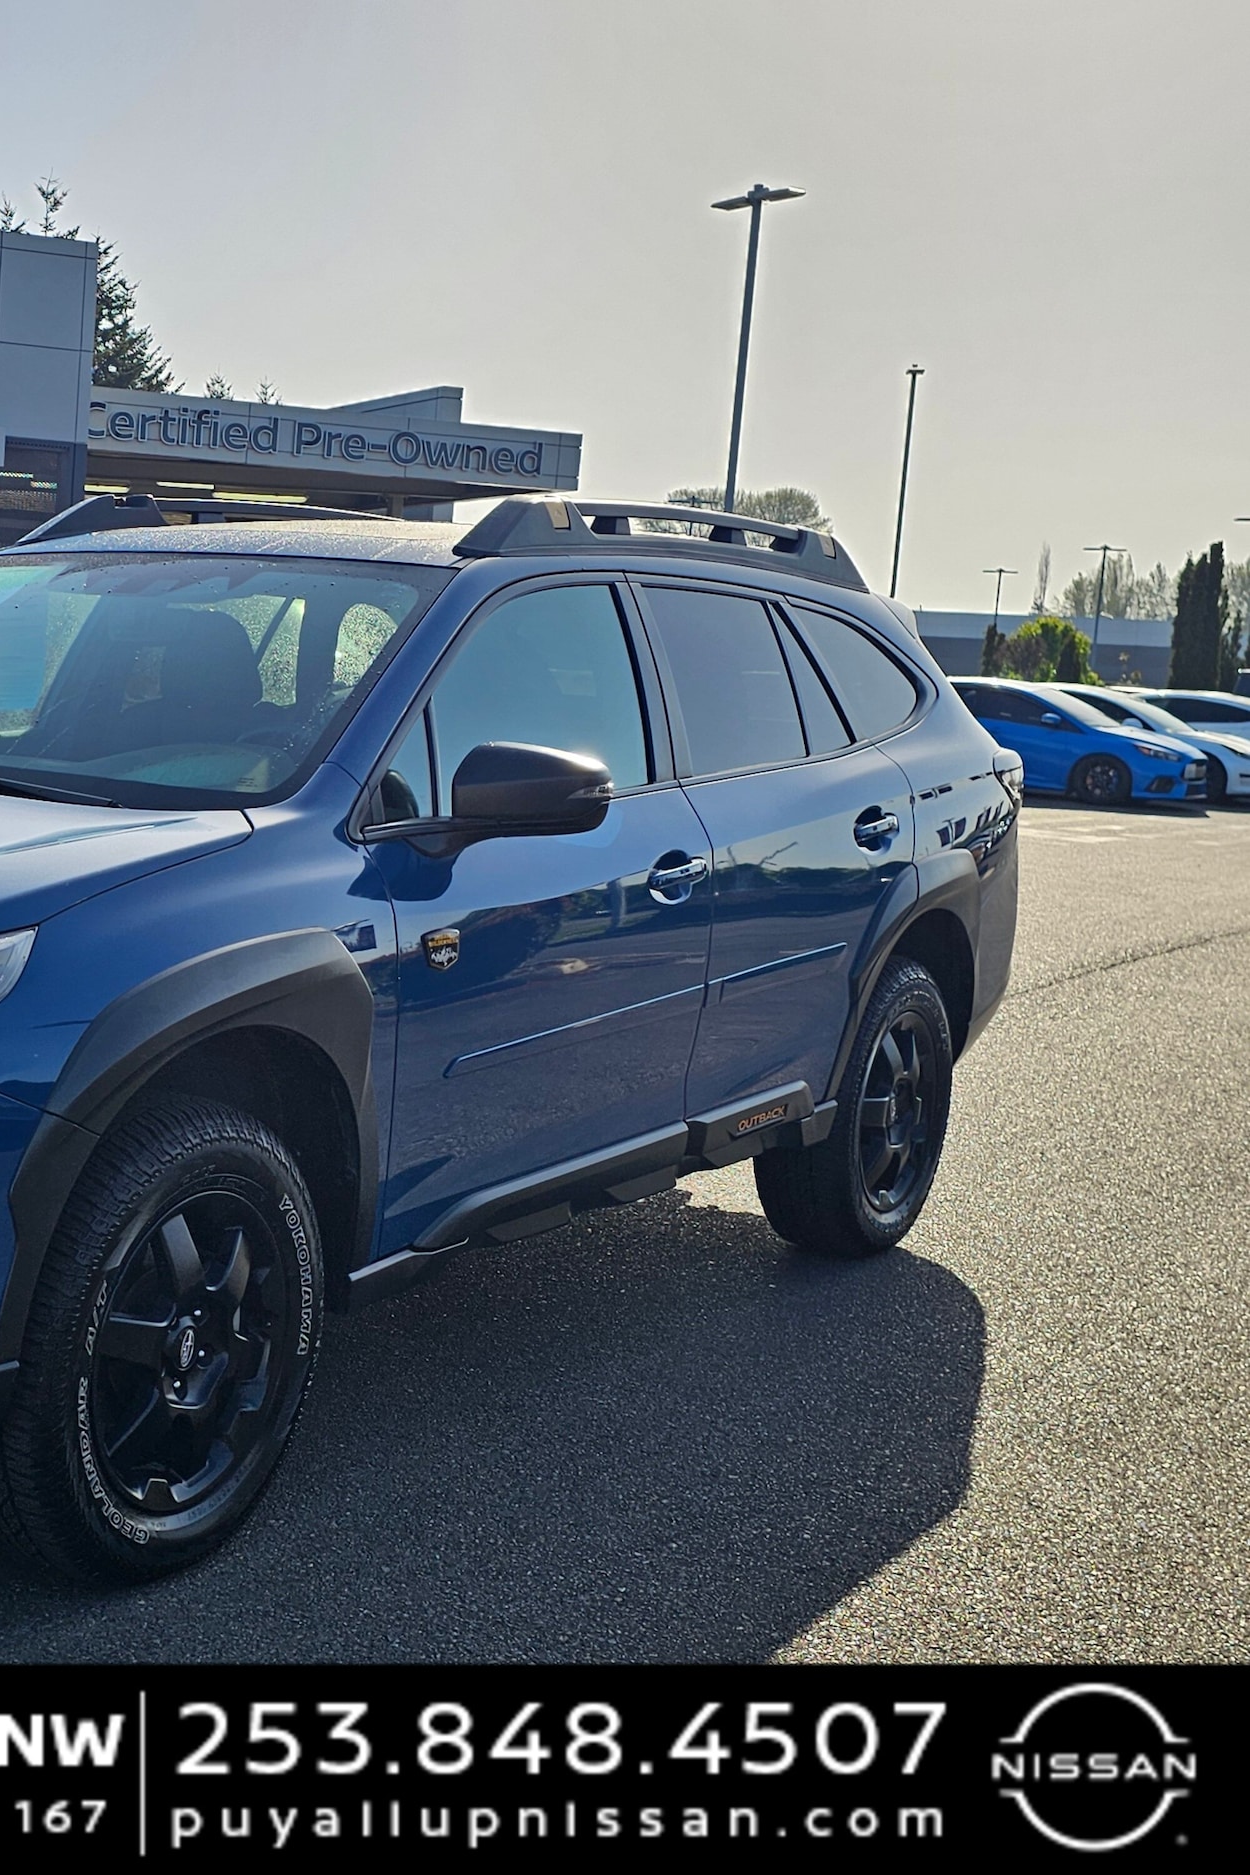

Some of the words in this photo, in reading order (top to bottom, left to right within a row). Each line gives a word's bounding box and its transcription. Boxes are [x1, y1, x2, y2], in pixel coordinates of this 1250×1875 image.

[293, 420, 544, 477] Pre-Owned
[737, 1104, 785, 1132] OUTBACK
[278, 1192, 314, 1356] YOKOHAMA
[77, 1375, 151, 1545] GEOLANDAR
